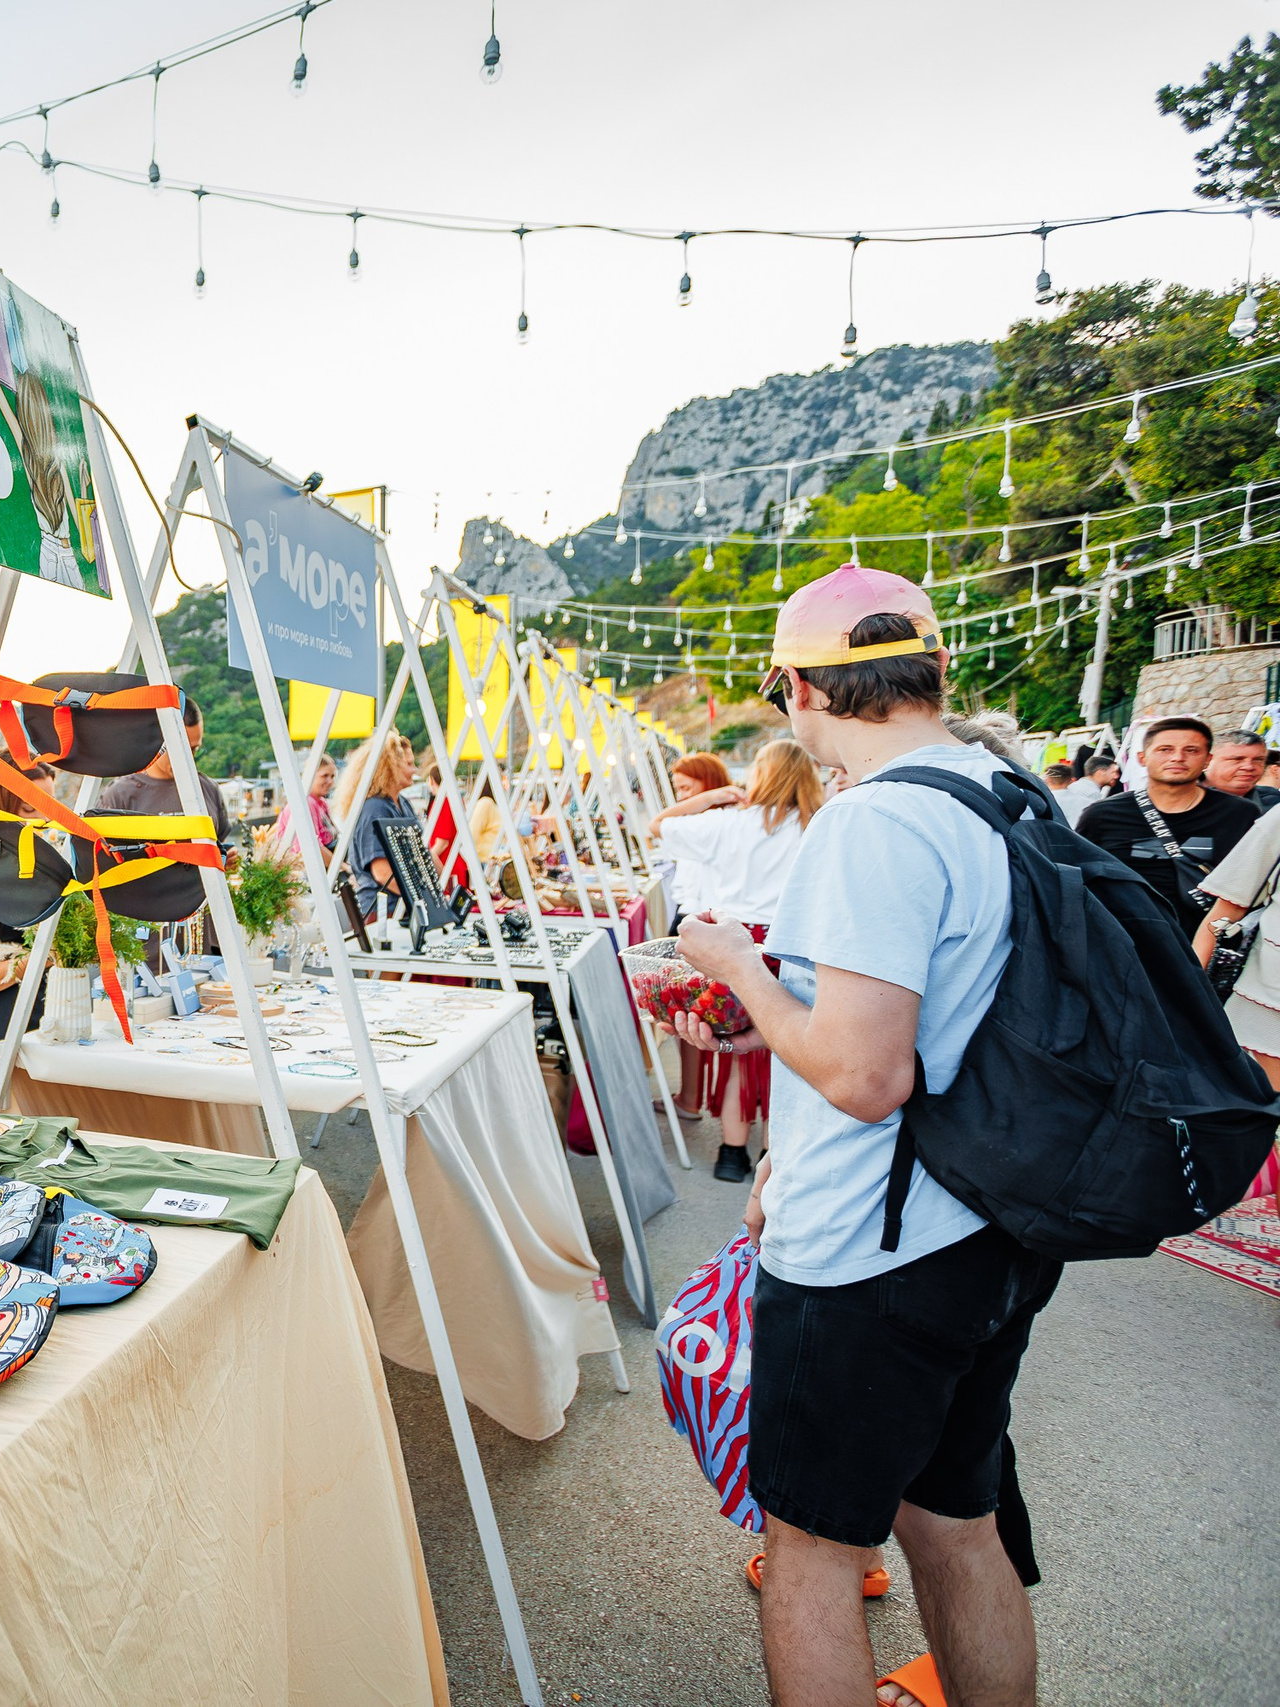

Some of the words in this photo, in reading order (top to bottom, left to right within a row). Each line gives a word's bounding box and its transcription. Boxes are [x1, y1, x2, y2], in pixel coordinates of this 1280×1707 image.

[274, 623, 289, 642] про
[290, 629, 309, 648] море
[316, 637, 329, 653] про
[329, 641, 354, 659] любовь
[1149, 819, 1173, 838] PLAY
